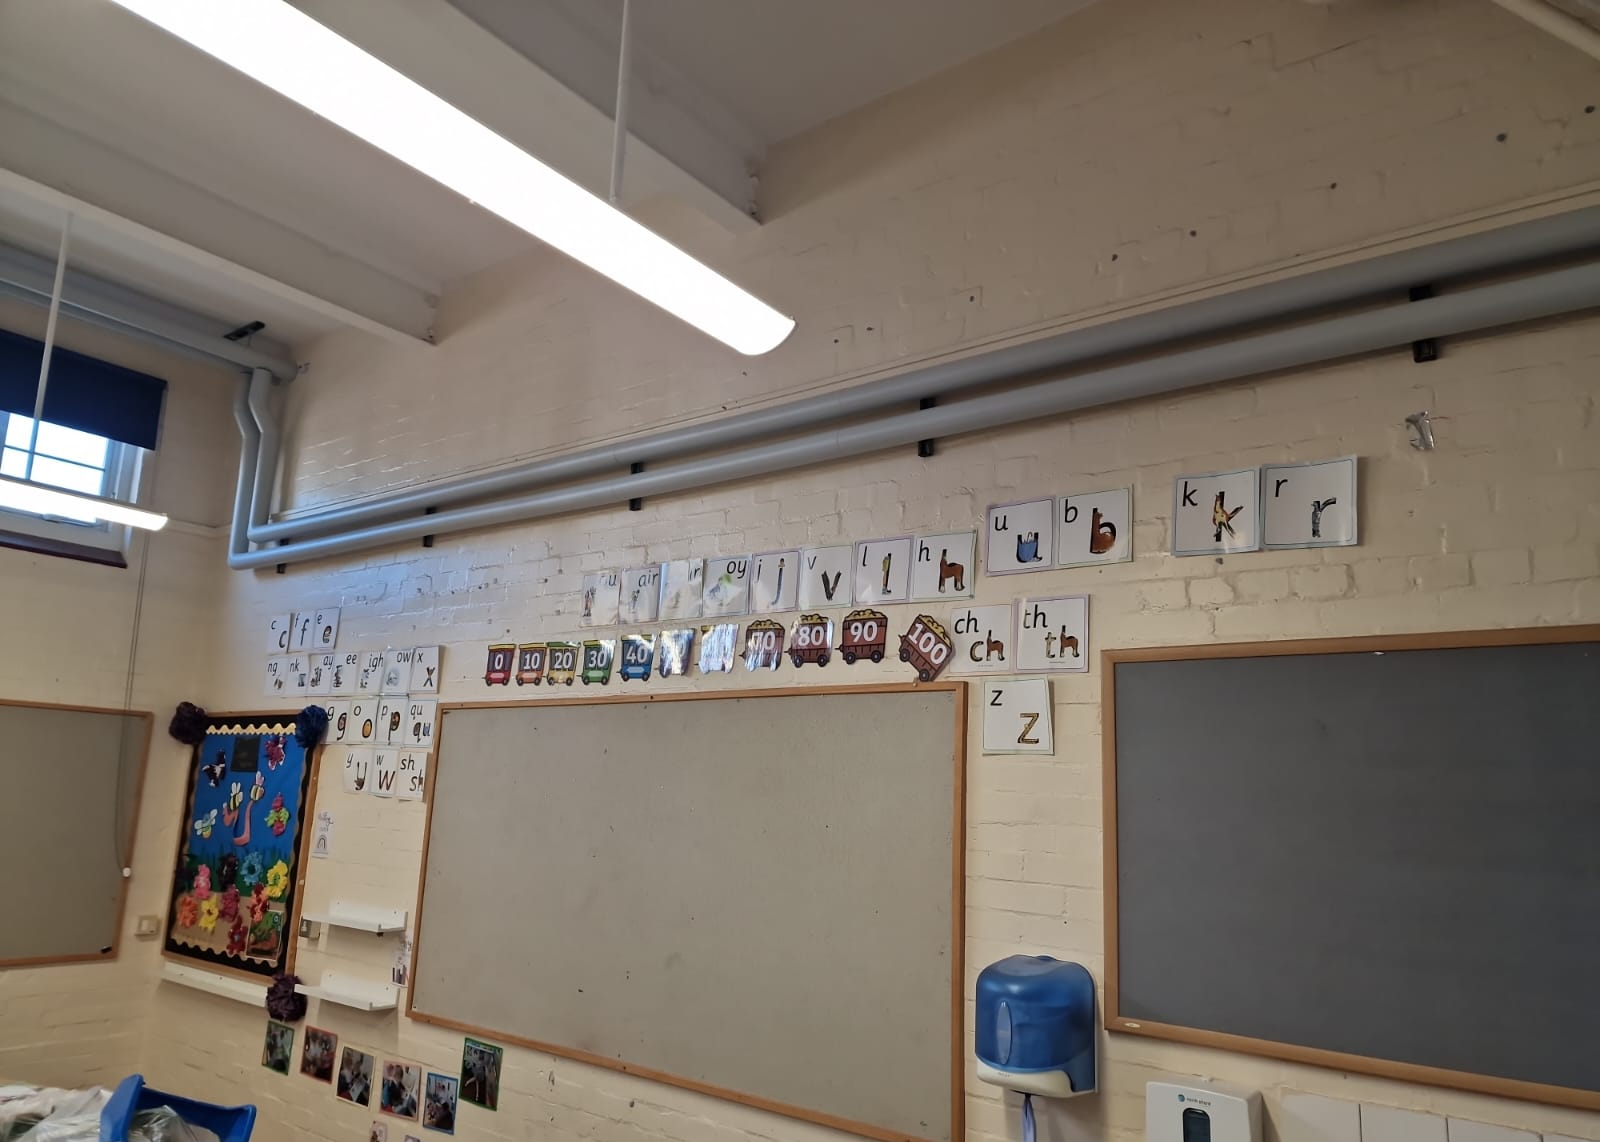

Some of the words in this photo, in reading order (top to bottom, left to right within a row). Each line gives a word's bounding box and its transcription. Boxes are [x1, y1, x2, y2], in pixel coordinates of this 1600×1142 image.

[1182, 481, 1198, 507] k
[1274, 476, 1288, 498] r
[1064, 499, 1078, 523] b
[994, 512, 1009, 532] u
[918, 540, 931, 562] h
[726, 560, 747, 579] oy
[807, 556, 817, 570] v
[639, 570, 659, 587] air
[954, 610, 979, 634] ch
[1023, 604, 1048, 629] th
[798, 625, 825, 646] 80
[850, 621, 878, 643] 90
[908, 622, 947, 665] 100
[323, 655, 334, 670] ay
[346, 653, 357, 665] ee
[369, 653, 384, 672] igh
[494, 653, 504, 669] 0
[524, 653, 540, 669] 10
[554, 652, 572, 668] 20
[588, 651, 607, 667] 30
[626, 646, 648, 664] 40
[410, 704, 423, 720] qu
[400, 754, 415, 770] sh
